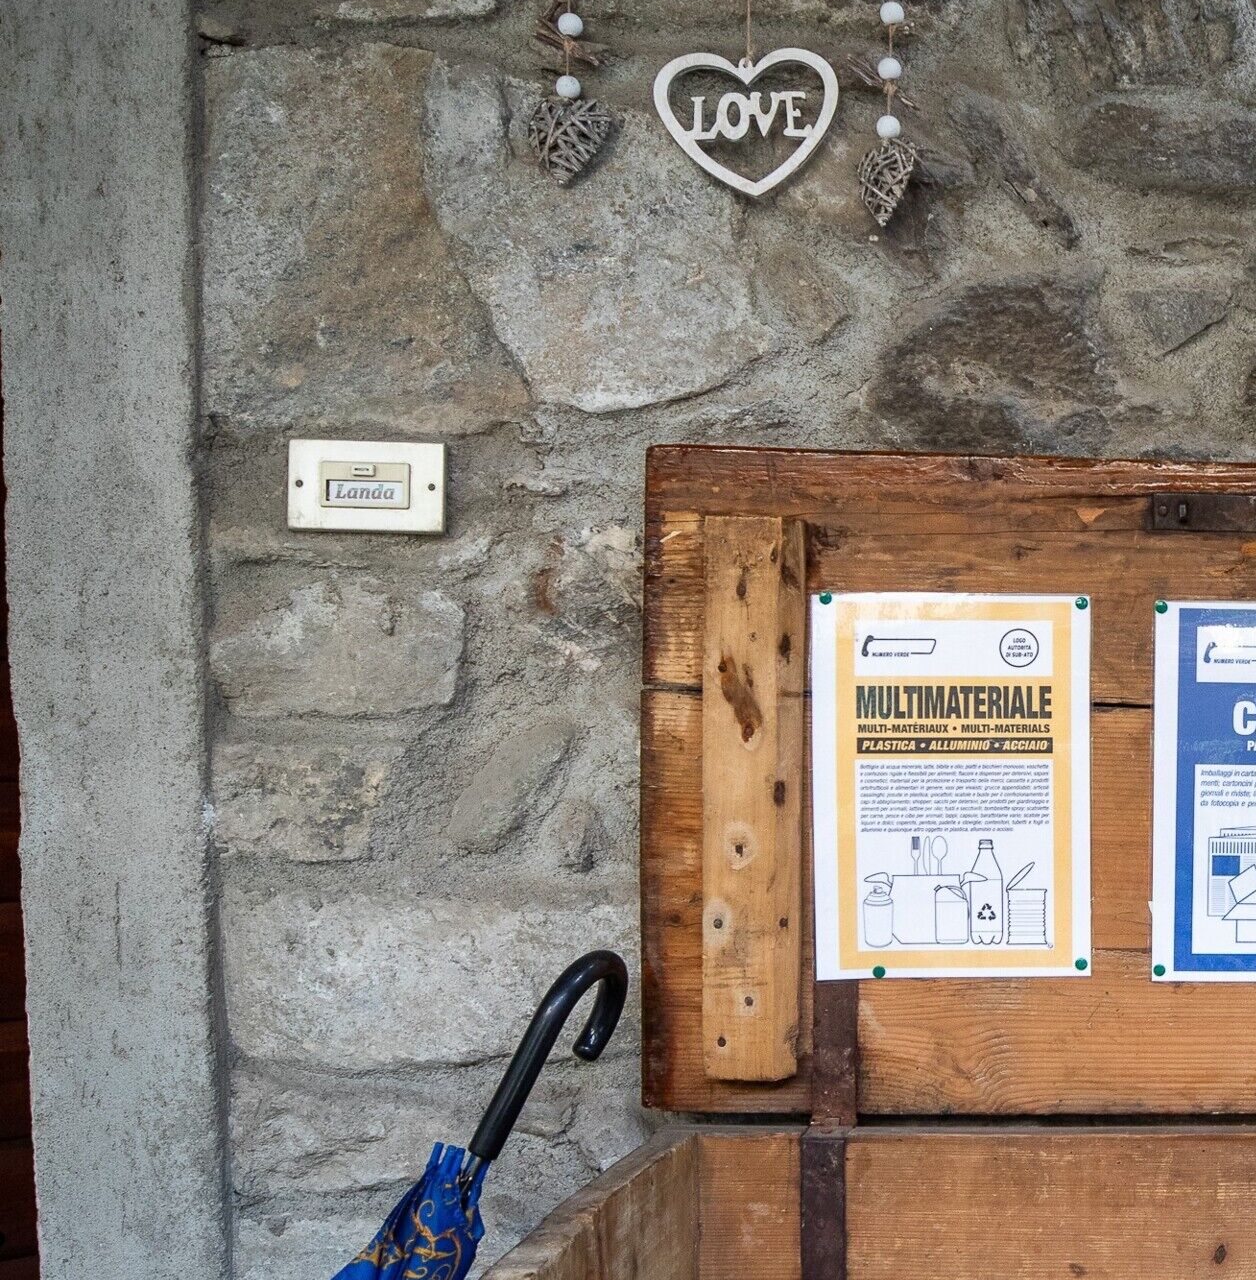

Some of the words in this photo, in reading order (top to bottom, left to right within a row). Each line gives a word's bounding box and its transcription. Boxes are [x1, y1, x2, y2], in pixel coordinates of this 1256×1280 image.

[690, 90, 813, 141] LOVE
[335, 484, 396, 500] Landa
[856, 686, 1052, 720] MULTIMATERIALE
[858, 722, 948, 733] MULTI-MATÉRIAUX
[961, 724, 1050, 733] MULTI-MATERIALS
[862, 740, 915, 750] PLASTICA
[929, 740, 990, 750] ALLUMINIO
[1003, 740, 1048, 750] ACCIAIO
